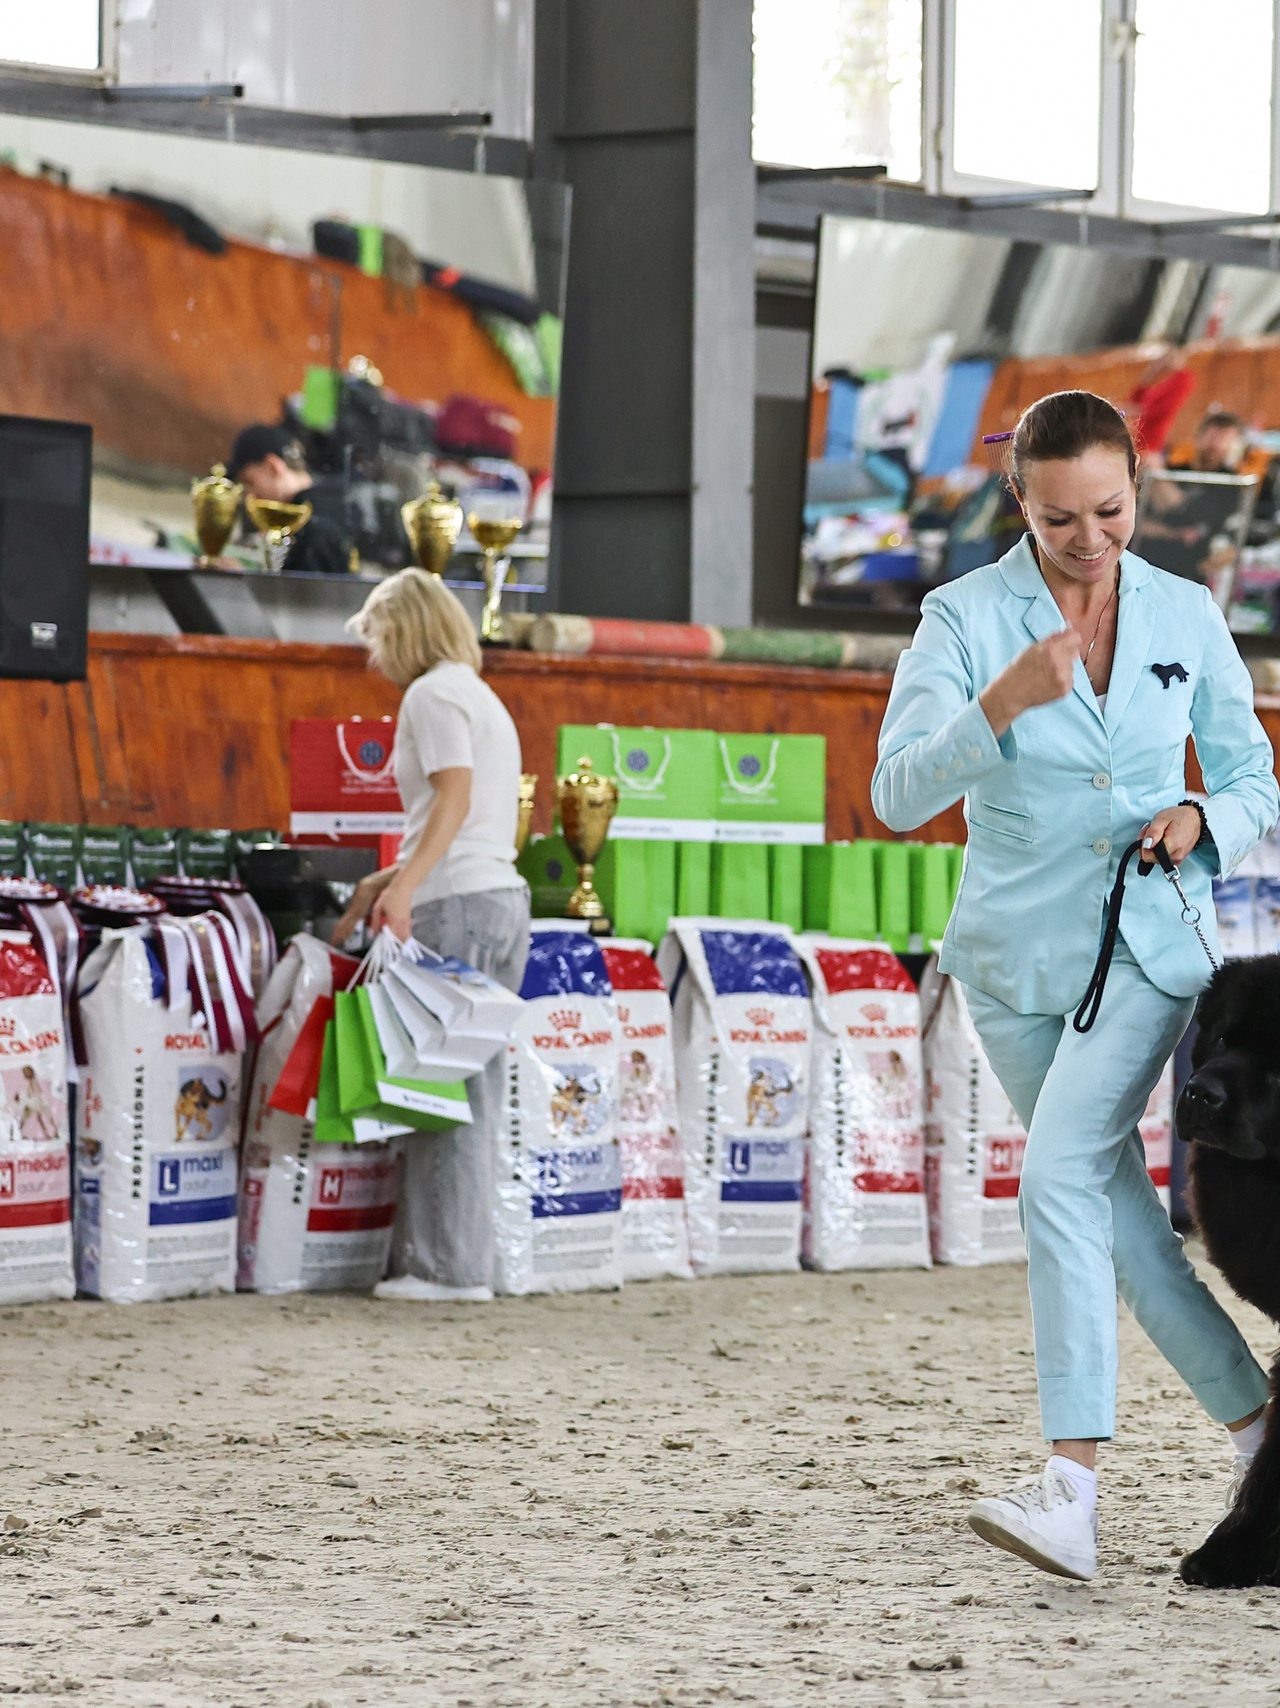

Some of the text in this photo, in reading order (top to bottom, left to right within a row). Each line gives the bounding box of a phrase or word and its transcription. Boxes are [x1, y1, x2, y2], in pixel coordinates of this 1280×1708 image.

[130, 1064, 145, 1200] PROFESSIONAL
[163, 1149, 224, 1192] L maxi
